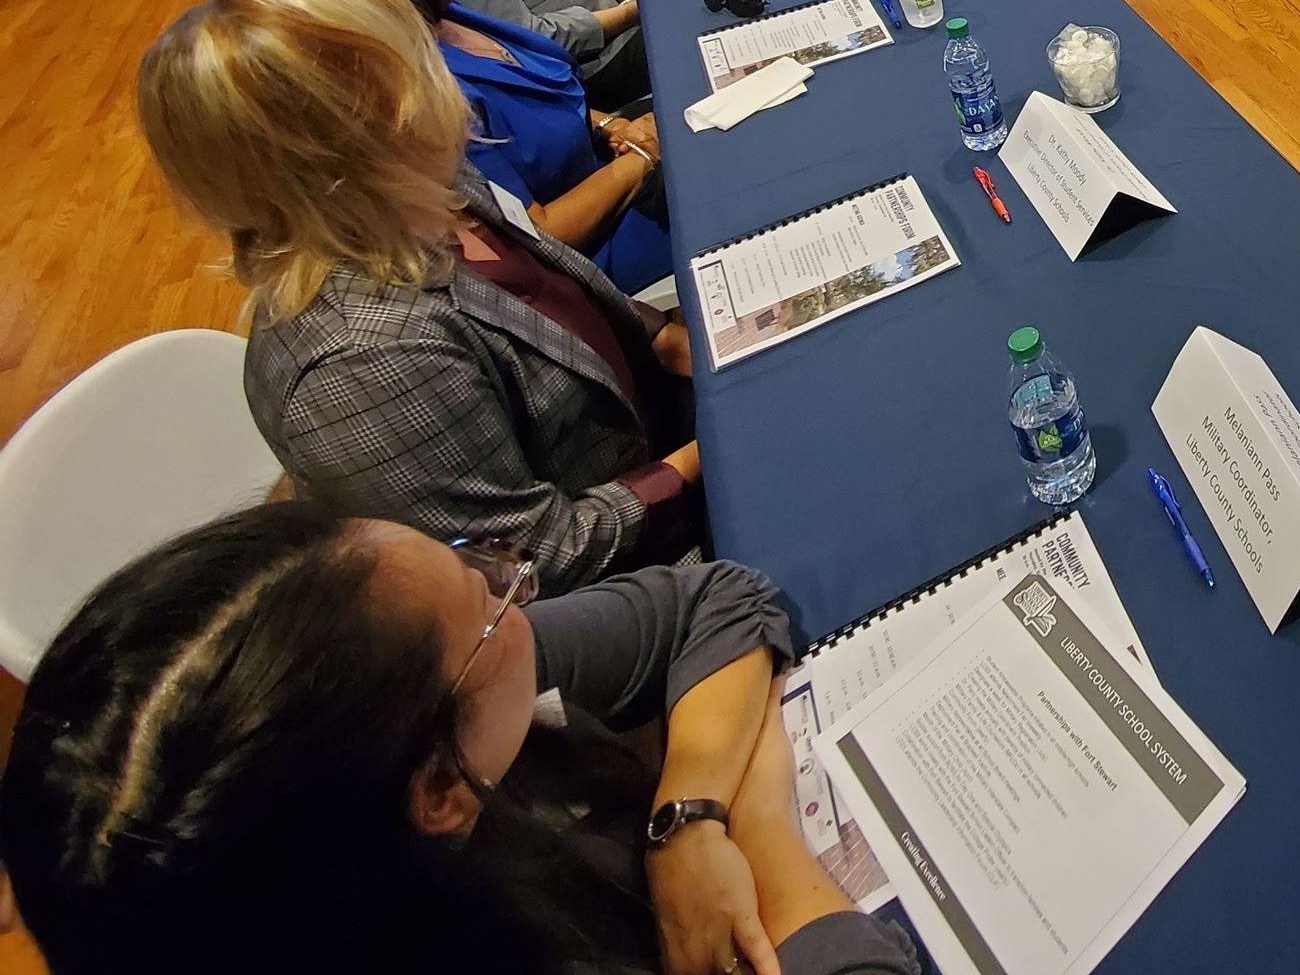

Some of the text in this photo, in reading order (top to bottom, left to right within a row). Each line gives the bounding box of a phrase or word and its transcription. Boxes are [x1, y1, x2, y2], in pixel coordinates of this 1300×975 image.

[894, 184, 914, 212] COMMUNITY
[1021, 130, 1097, 227] Executive Director of Student Services
[1023, 163, 1073, 223] Liberty County Schools
[1046, 134, 1088, 185] Dr. Kathy Moody
[883, 188, 916, 240] PARTNERSHIPS FORUM
[1199, 416, 1278, 544] Military Coordinator,
[1221, 406, 1283, 502] Melaniann Pass
[1184, 433, 1267, 573] Liberty County Schools
[1054, 531, 1090, 590] COMMUNITY
[1035, 690, 1119, 792] Partnerships with Fort Stewart
[1058, 636, 1189, 785] LIBERTY COUNTY SCHOOL SYSTEM
[898, 830, 949, 902] Creating Excellence
